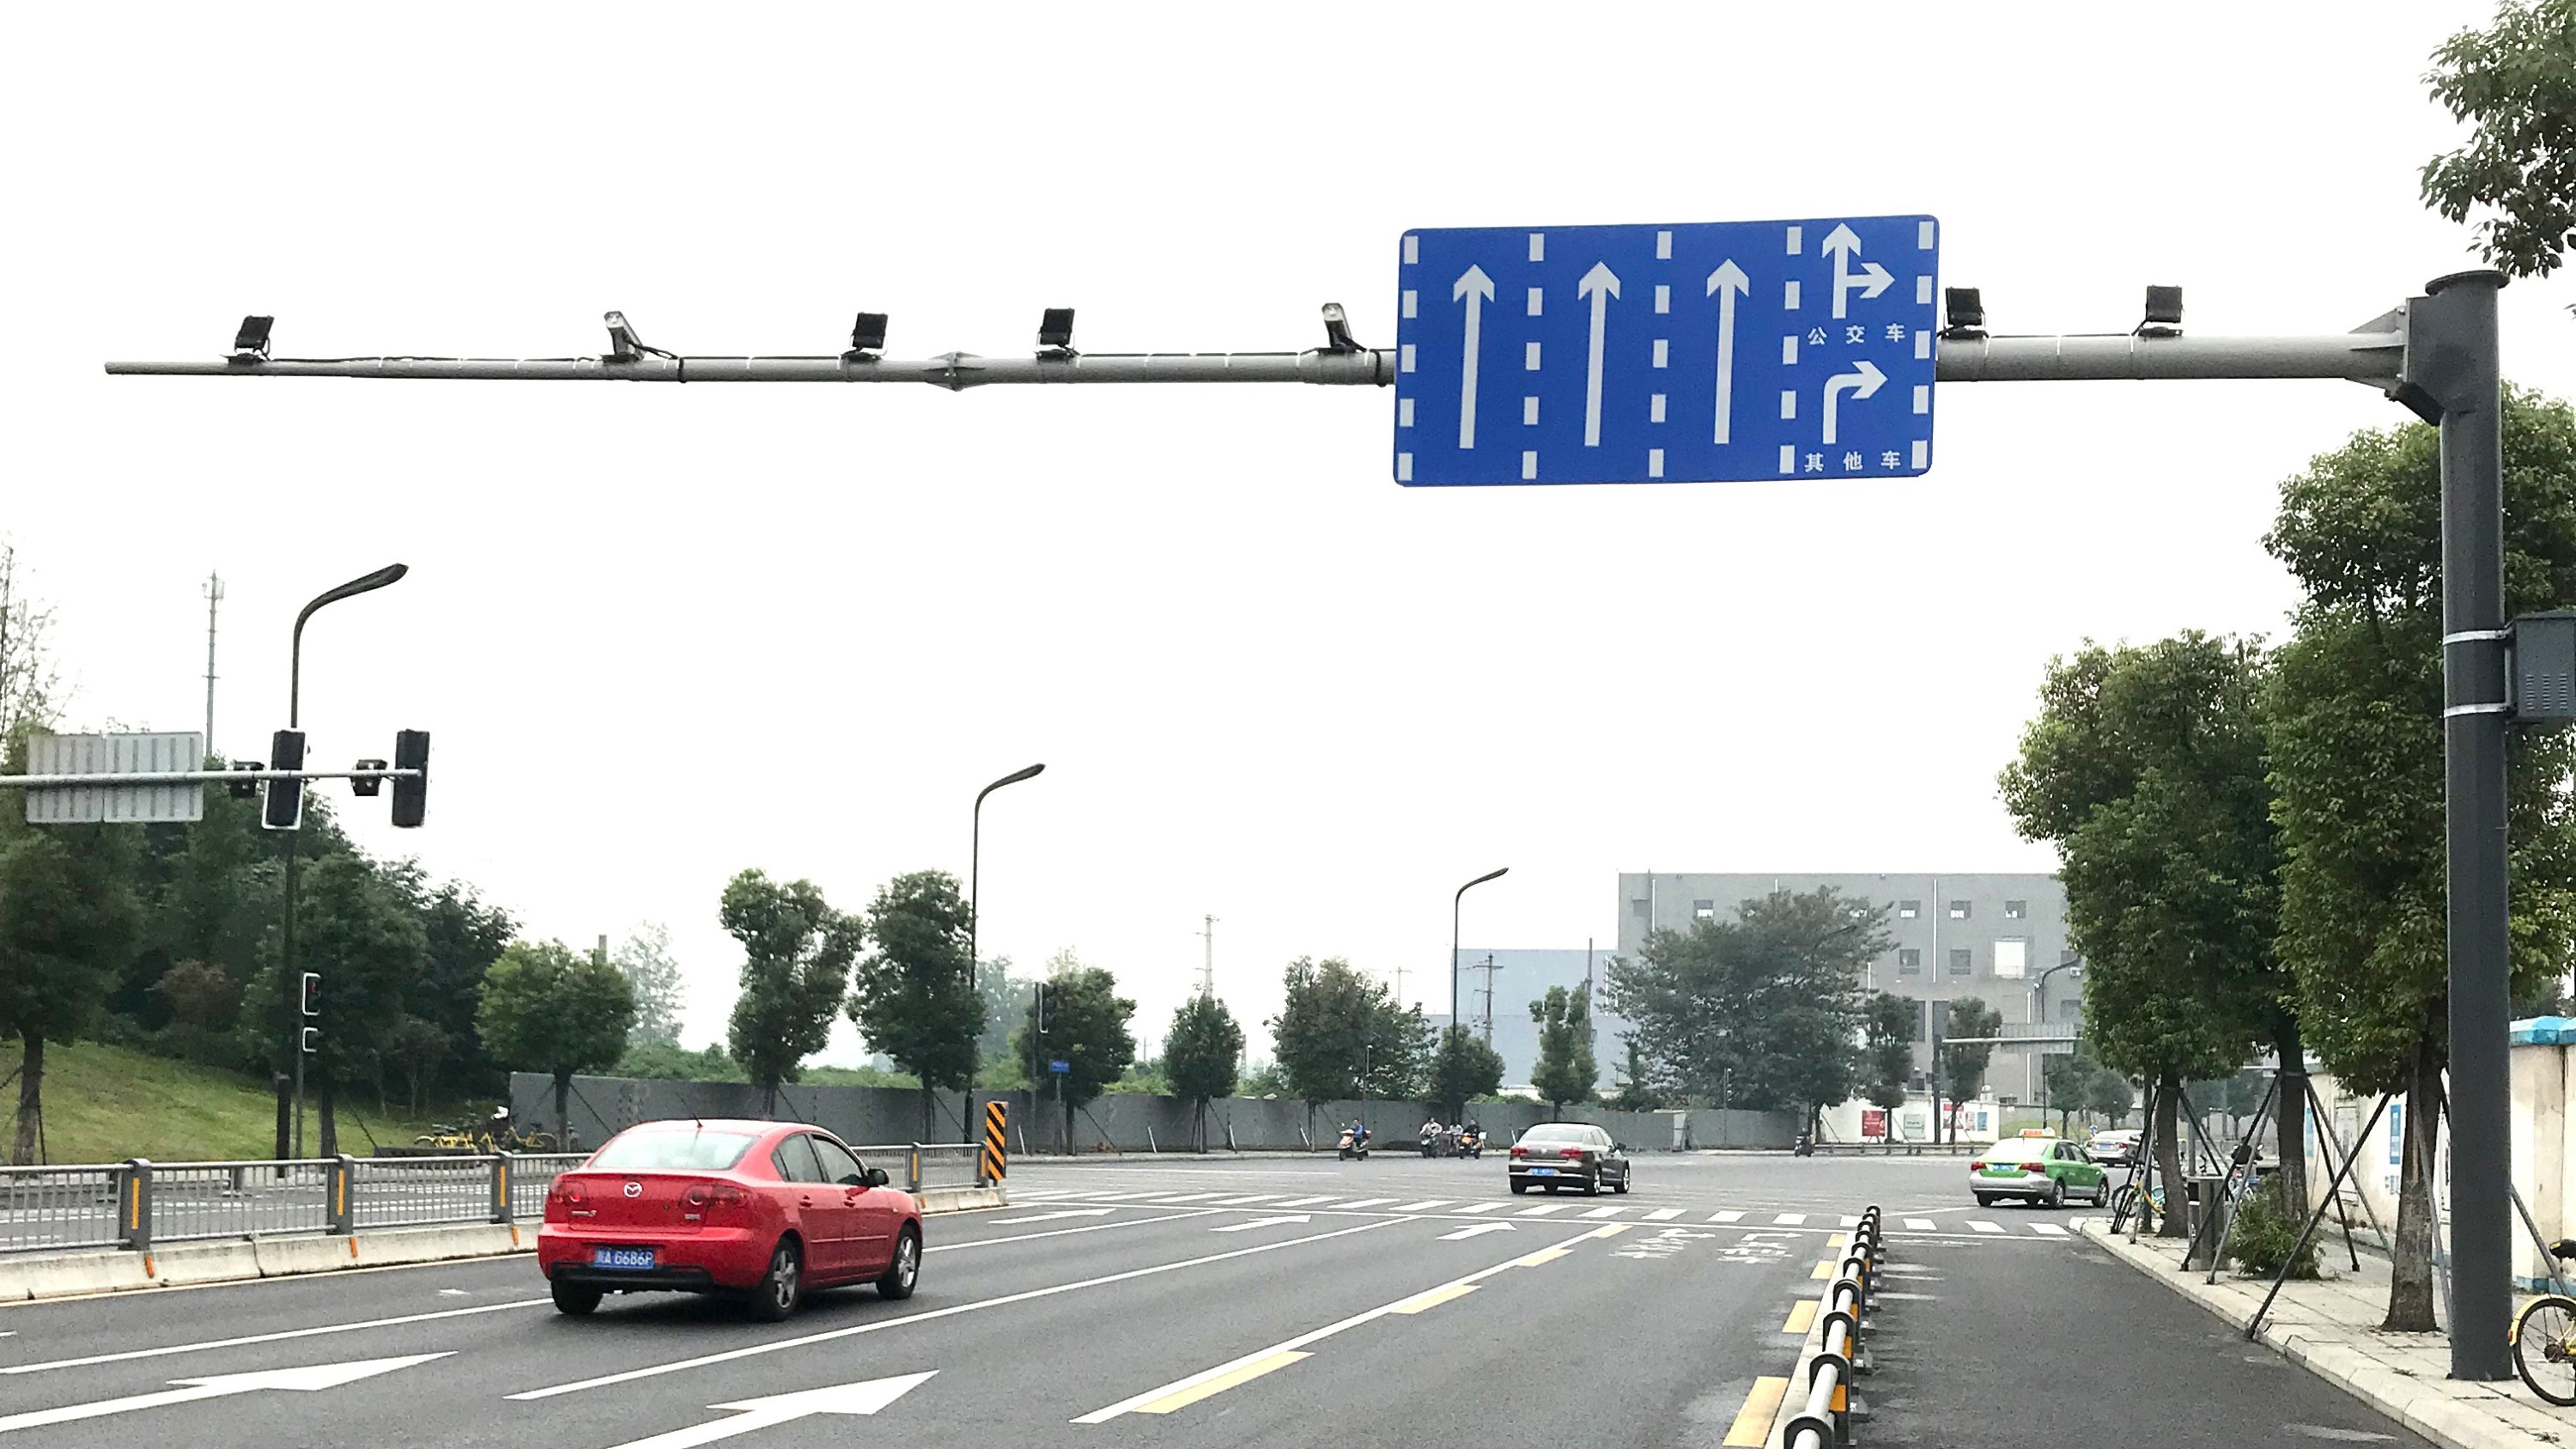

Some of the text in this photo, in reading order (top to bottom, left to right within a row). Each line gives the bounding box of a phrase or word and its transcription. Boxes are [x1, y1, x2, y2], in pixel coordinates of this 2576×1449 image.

[1807, 323, 1905, 345] 公交车
[1804, 451, 1901, 472] 其他车
